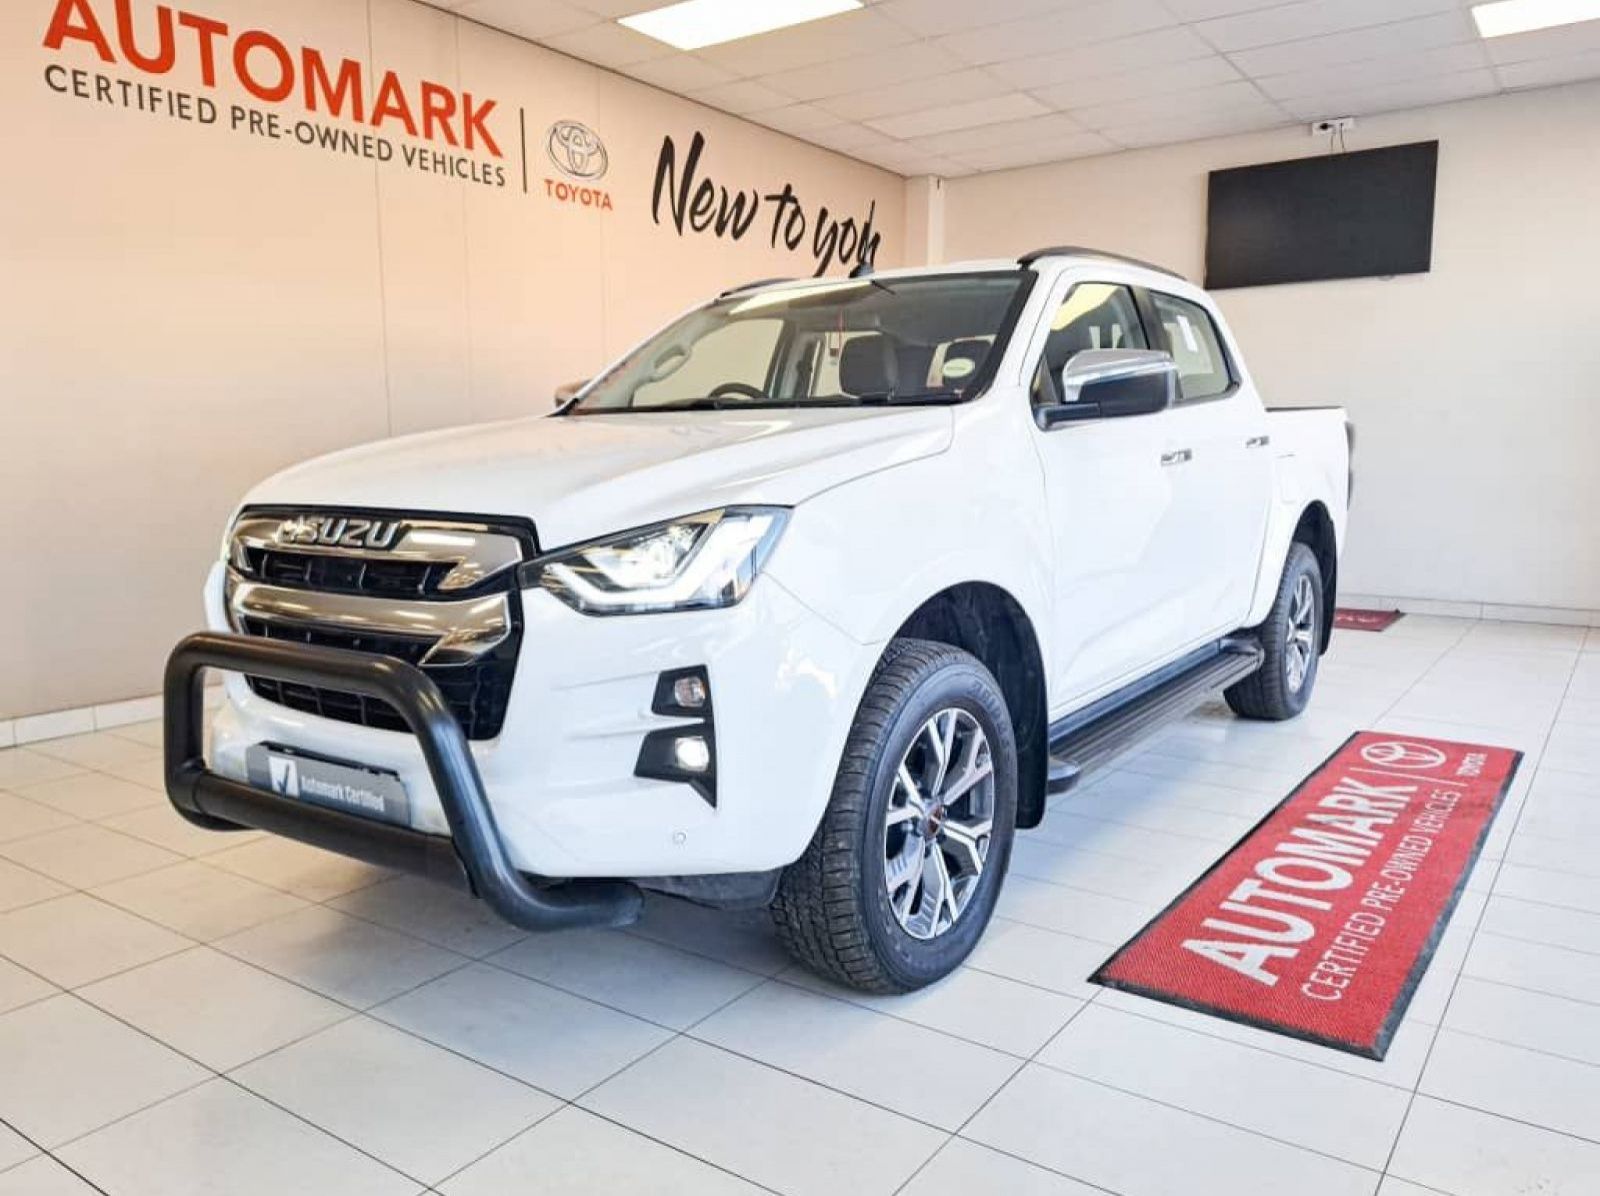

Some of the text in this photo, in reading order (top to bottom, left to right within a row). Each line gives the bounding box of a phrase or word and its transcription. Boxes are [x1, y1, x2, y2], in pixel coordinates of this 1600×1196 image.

[43, 0, 504, 158] AUTOMARK
[44, 64, 506, 187] CERTIFIED PRE-OWNED VEHICLES
[544, 178, 613, 211] TOYOTA
[652, 131, 758, 241] New
[764, 183, 806, 251] to
[1182, 776, 1418, 987] AUTOMARK
[1301, 911, 1386, 1001] CERTIFIED
[1360, 835, 1432, 912] PRE-OWNED
